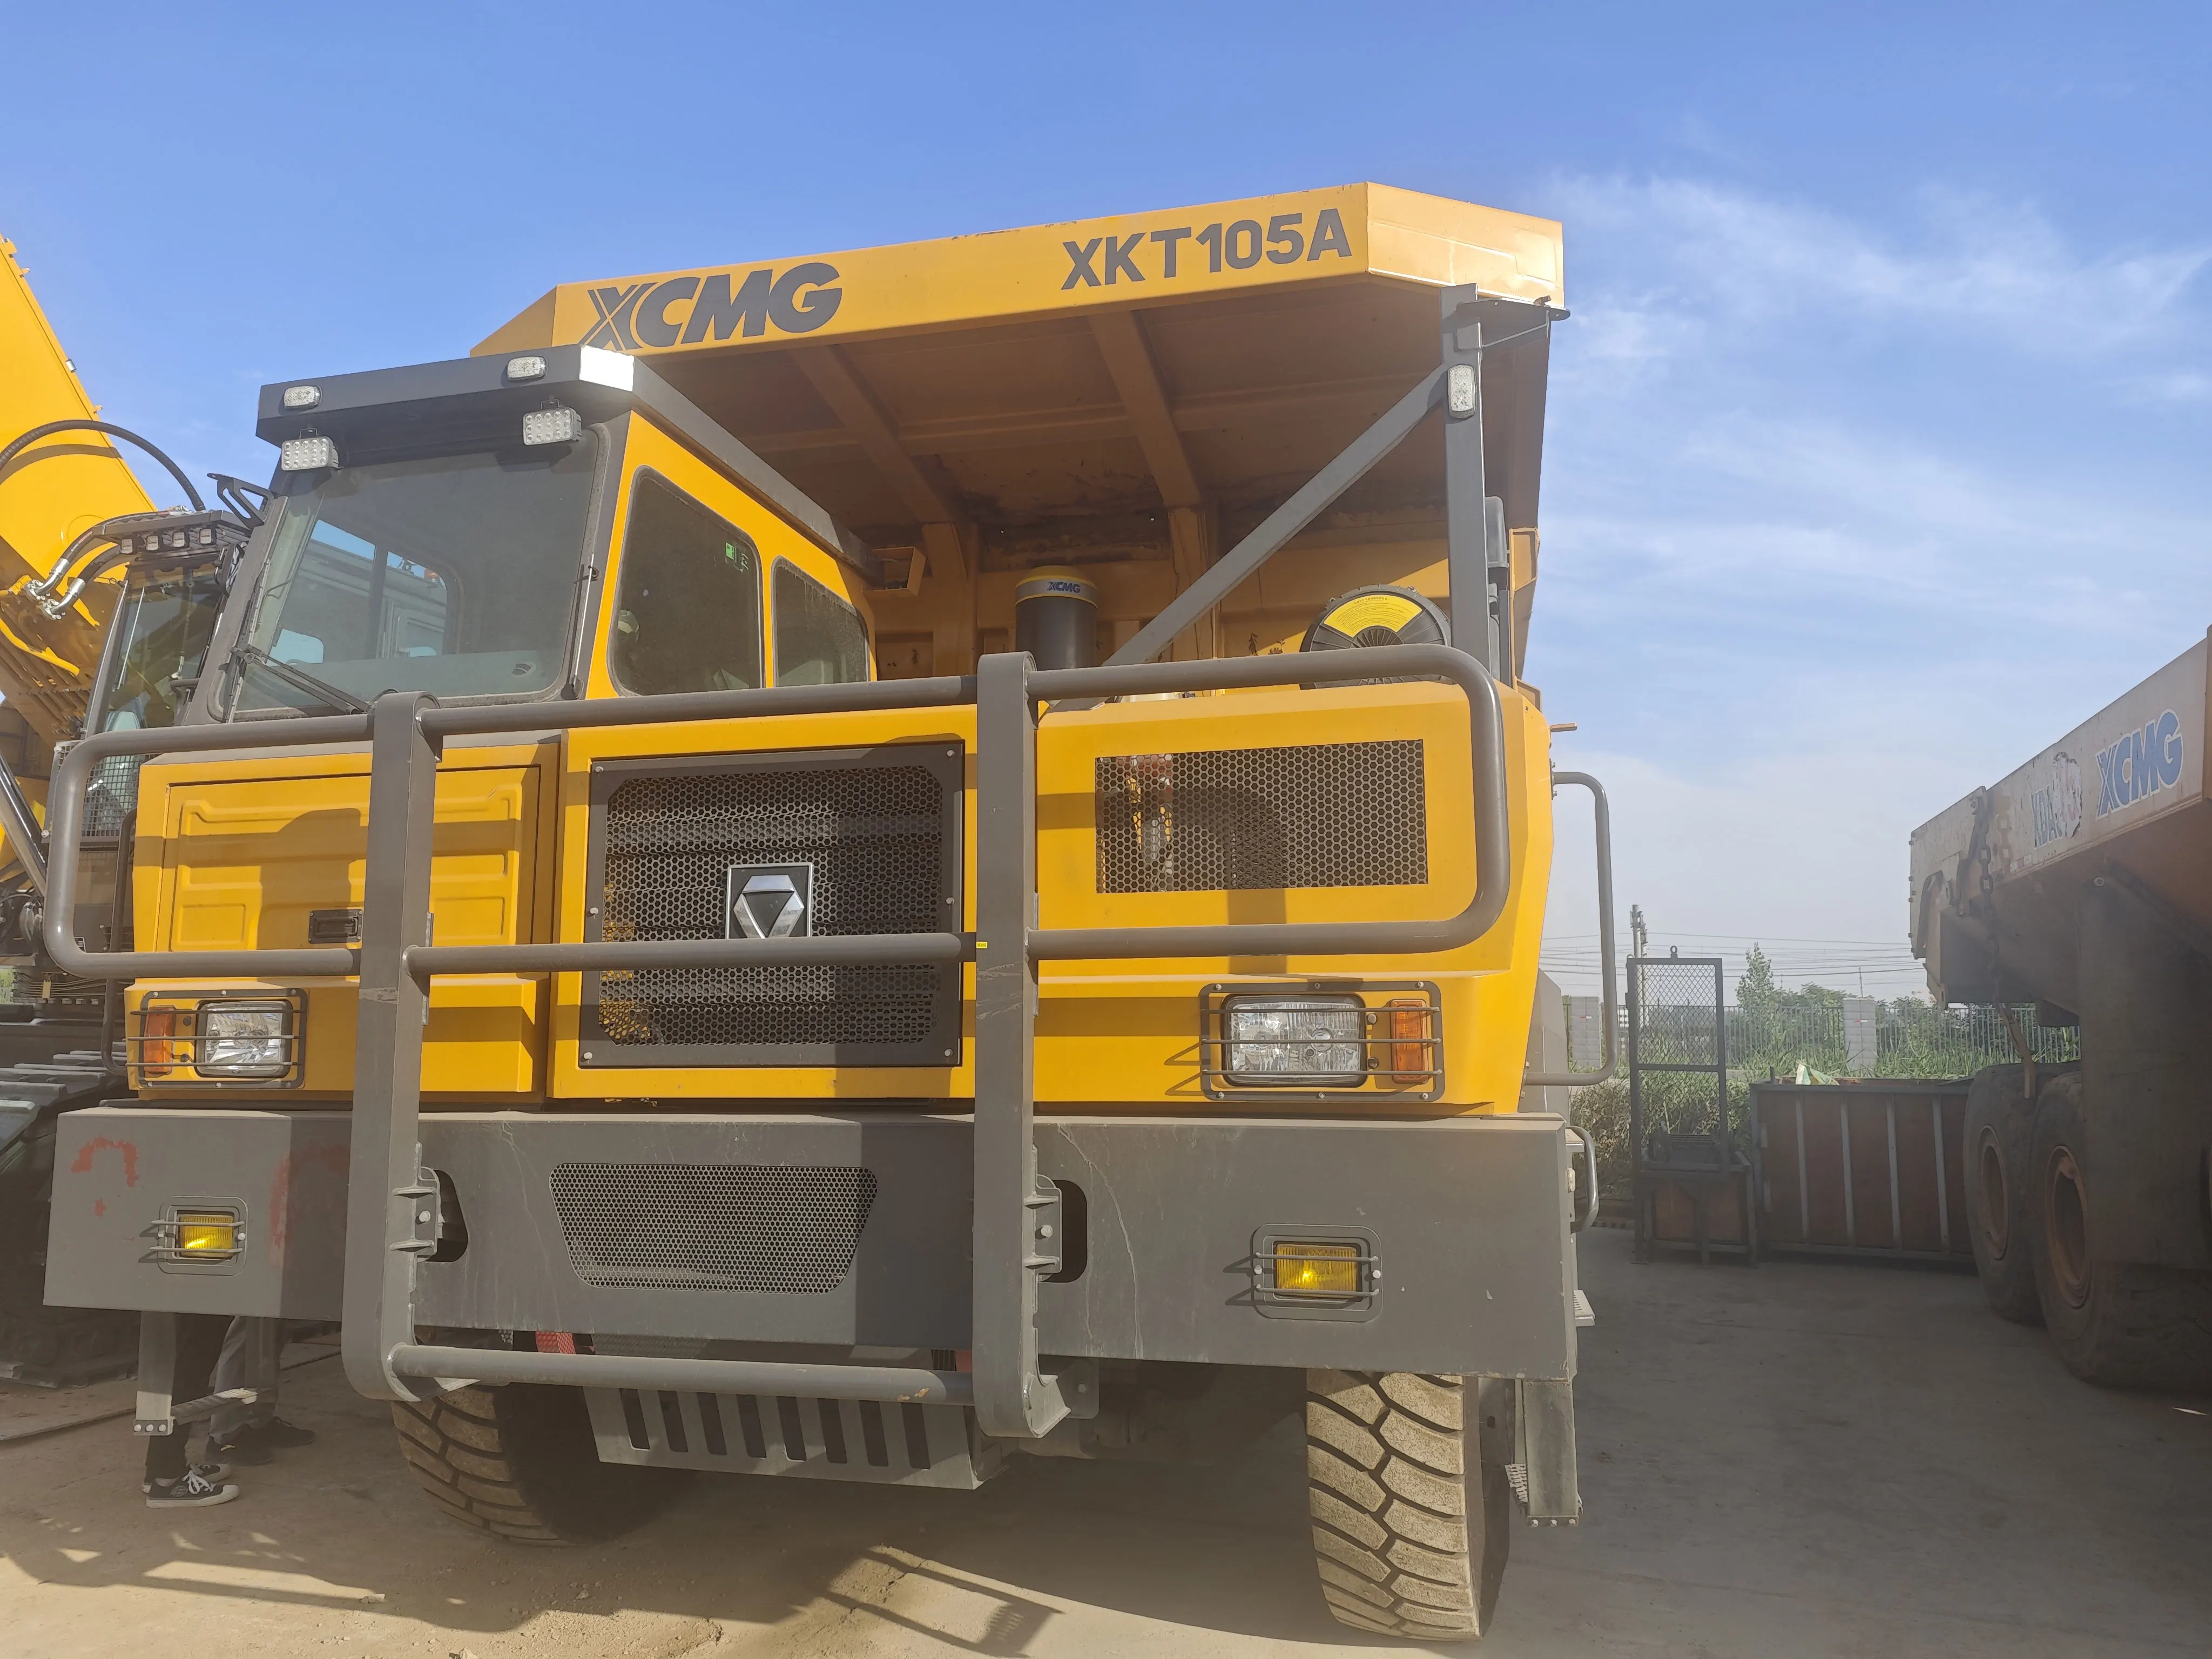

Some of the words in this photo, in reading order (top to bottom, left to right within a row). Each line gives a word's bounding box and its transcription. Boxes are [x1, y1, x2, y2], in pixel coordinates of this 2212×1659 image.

[1061, 208, 1352, 291] XKT105A
[579, 262, 842, 350] XCMG
[1047, 581, 1081, 593] XCMG
[2095, 709, 2183, 820] XCMG
